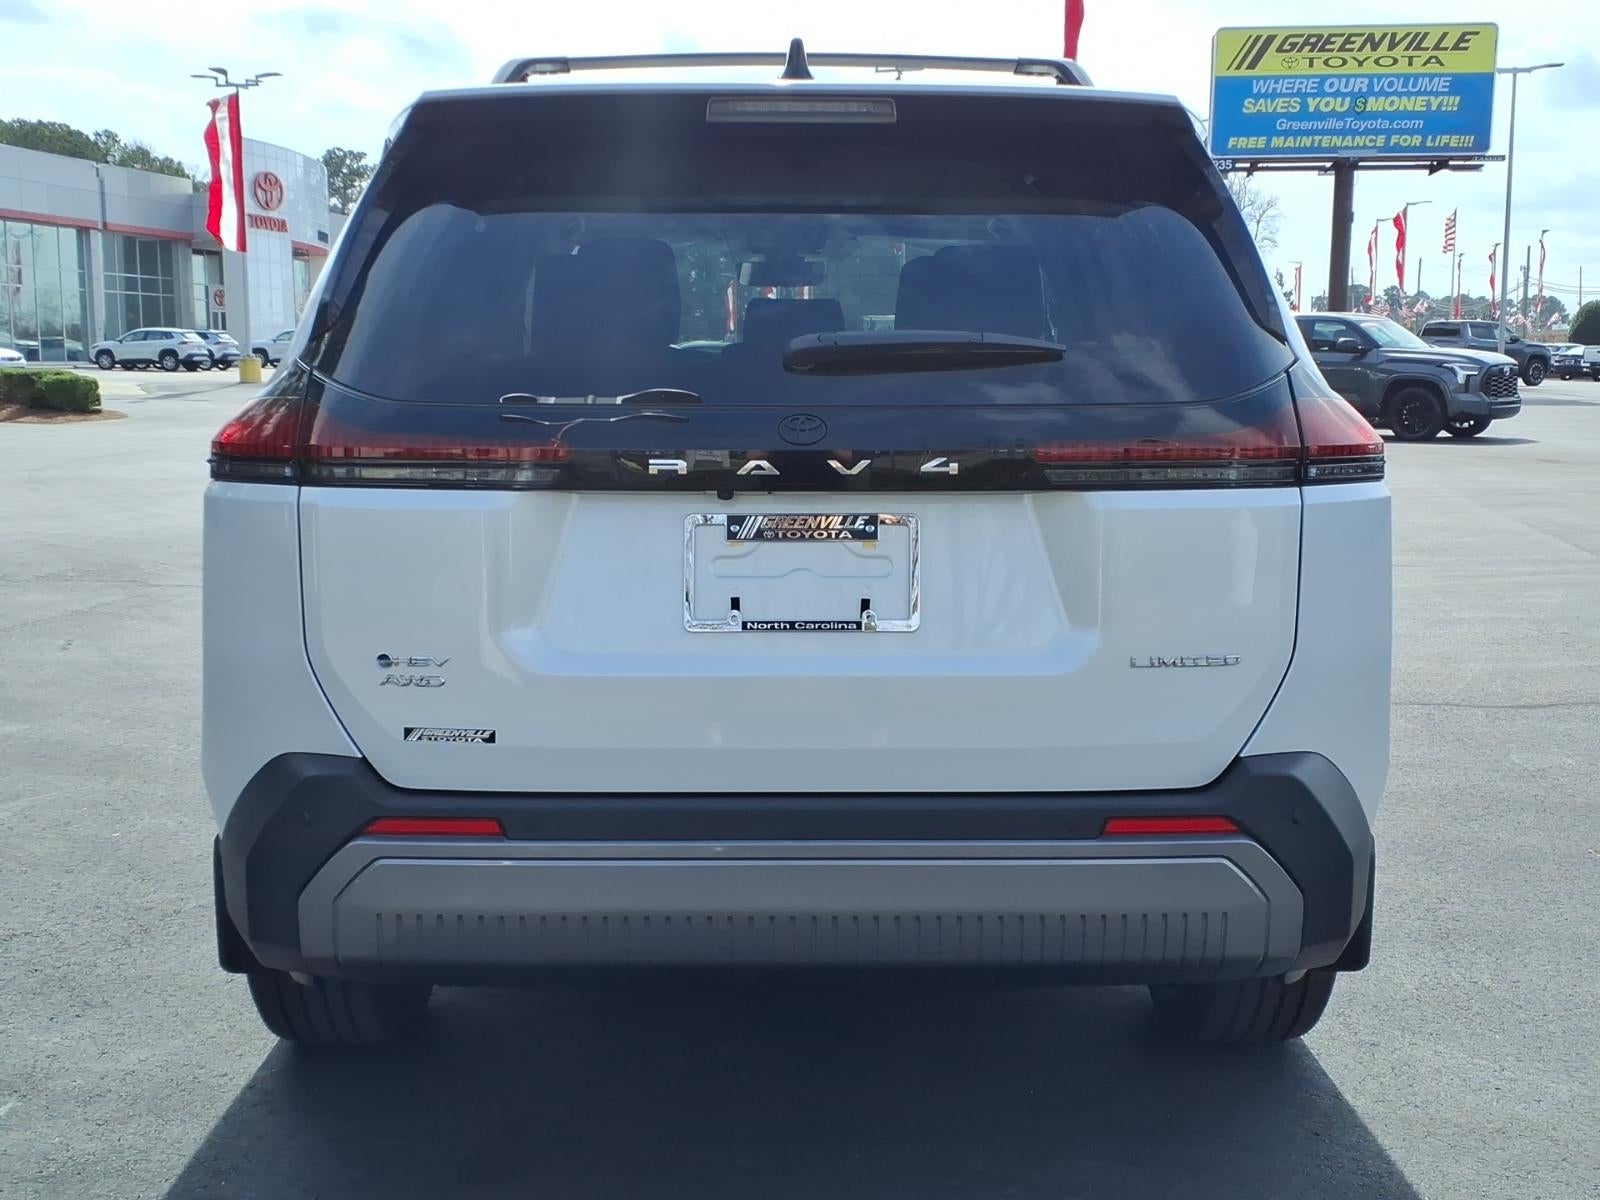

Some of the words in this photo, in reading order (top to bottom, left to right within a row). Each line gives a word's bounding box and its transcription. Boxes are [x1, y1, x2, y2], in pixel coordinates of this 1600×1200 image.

[1275, 31, 1480, 53] GREENVILLE
[1299, 55, 1446, 68] TOYOTA
[1252, 78, 1319, 93] WHERE
[1323, 77, 1368, 92] OUR
[1373, 77, 1452, 92] VOLUME
[1242, 98, 1300, 114] SAVES
[1307, 97, 1350, 112] YOU
[1276, 117, 1423, 132] GreenvilleToyota.com
[1227, 137, 1266, 149] FREE
[1270, 135, 1385, 149] MAINTENANCE
[1390, 135, 1422, 147] FOR
[1425, 134, 1475, 147] LIFE!!!
[247, 213, 288, 233] TOYOTA
[760, 515, 870, 529] GREENVILLE
[778, 530, 852, 539] TOYOTA
[747, 621, 790, 630] North
[795, 621, 857, 630] Carolina
[1130, 654, 1241, 668] LIMITED
[380, 674, 446, 688] AWD
[423, 728, 493, 738] GREENVILLE
